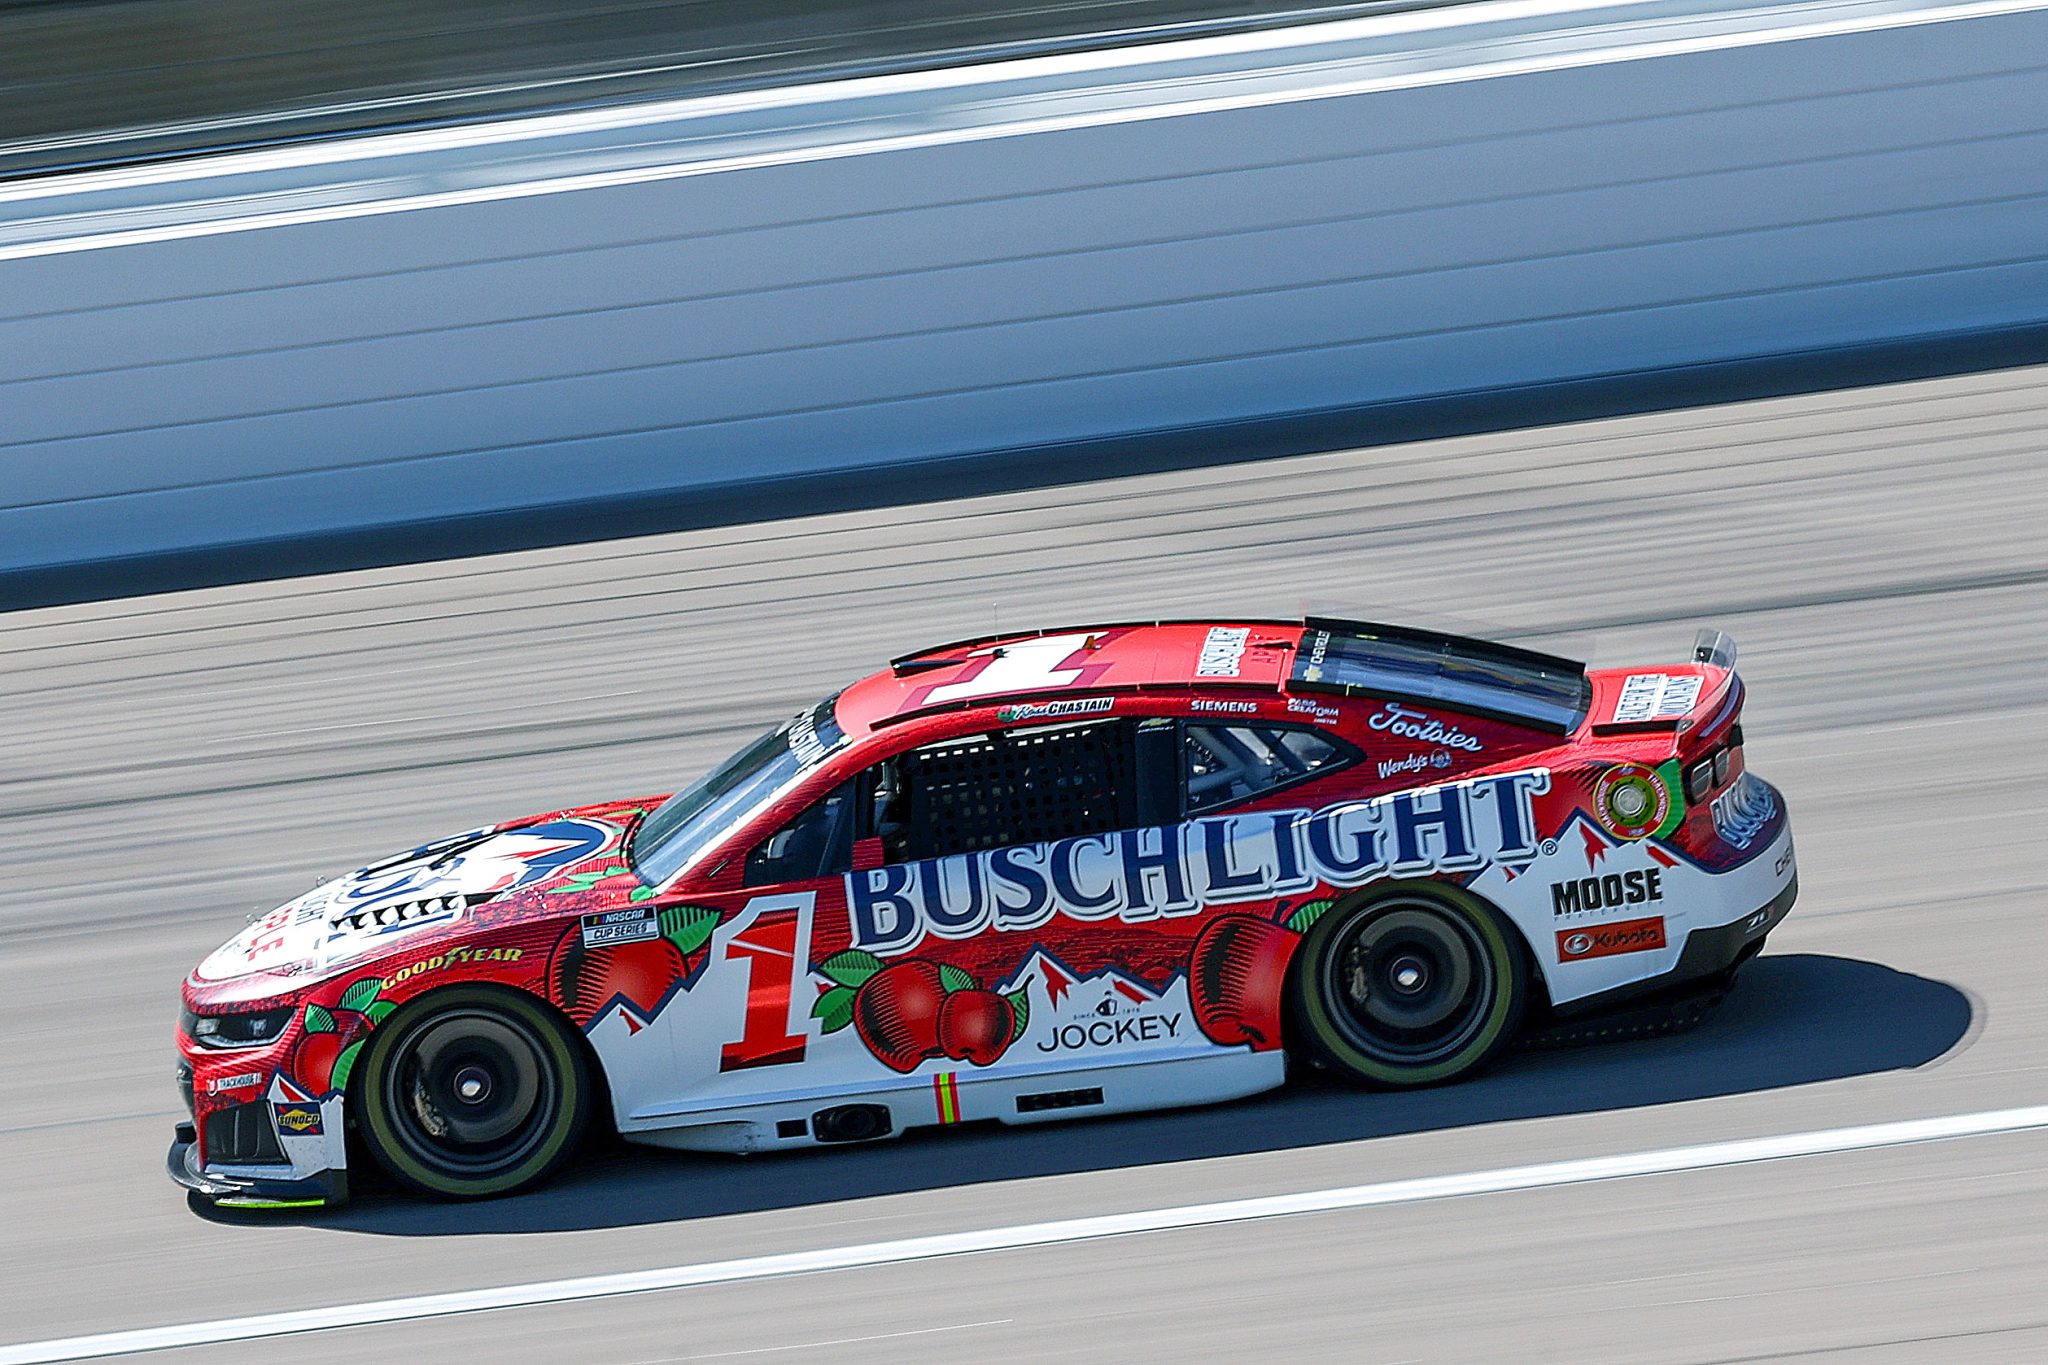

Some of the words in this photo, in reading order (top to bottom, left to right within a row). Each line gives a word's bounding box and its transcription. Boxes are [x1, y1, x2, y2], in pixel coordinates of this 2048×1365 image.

[1048, 699, 1113, 715] CHASTAIN
[1190, 700, 1257, 713] SIEMENS
[1368, 703, 1483, 752] Tootsies
[1378, 753, 1428, 779] Wendy's
[1551, 867, 1664, 916] MOOSE
[605, 909, 646, 924] NASCAR
[594, 928, 614, 939] CUP
[614, 921, 648, 936] SERIES
[1593, 927, 1661, 947] Kubota
[381, 945, 525, 990] GOODYEAR
[719, 905, 810, 1074] 1
[1036, 1012, 1181, 1052] JOCKEY
[278, 1113, 320, 1126] SUNOCO
